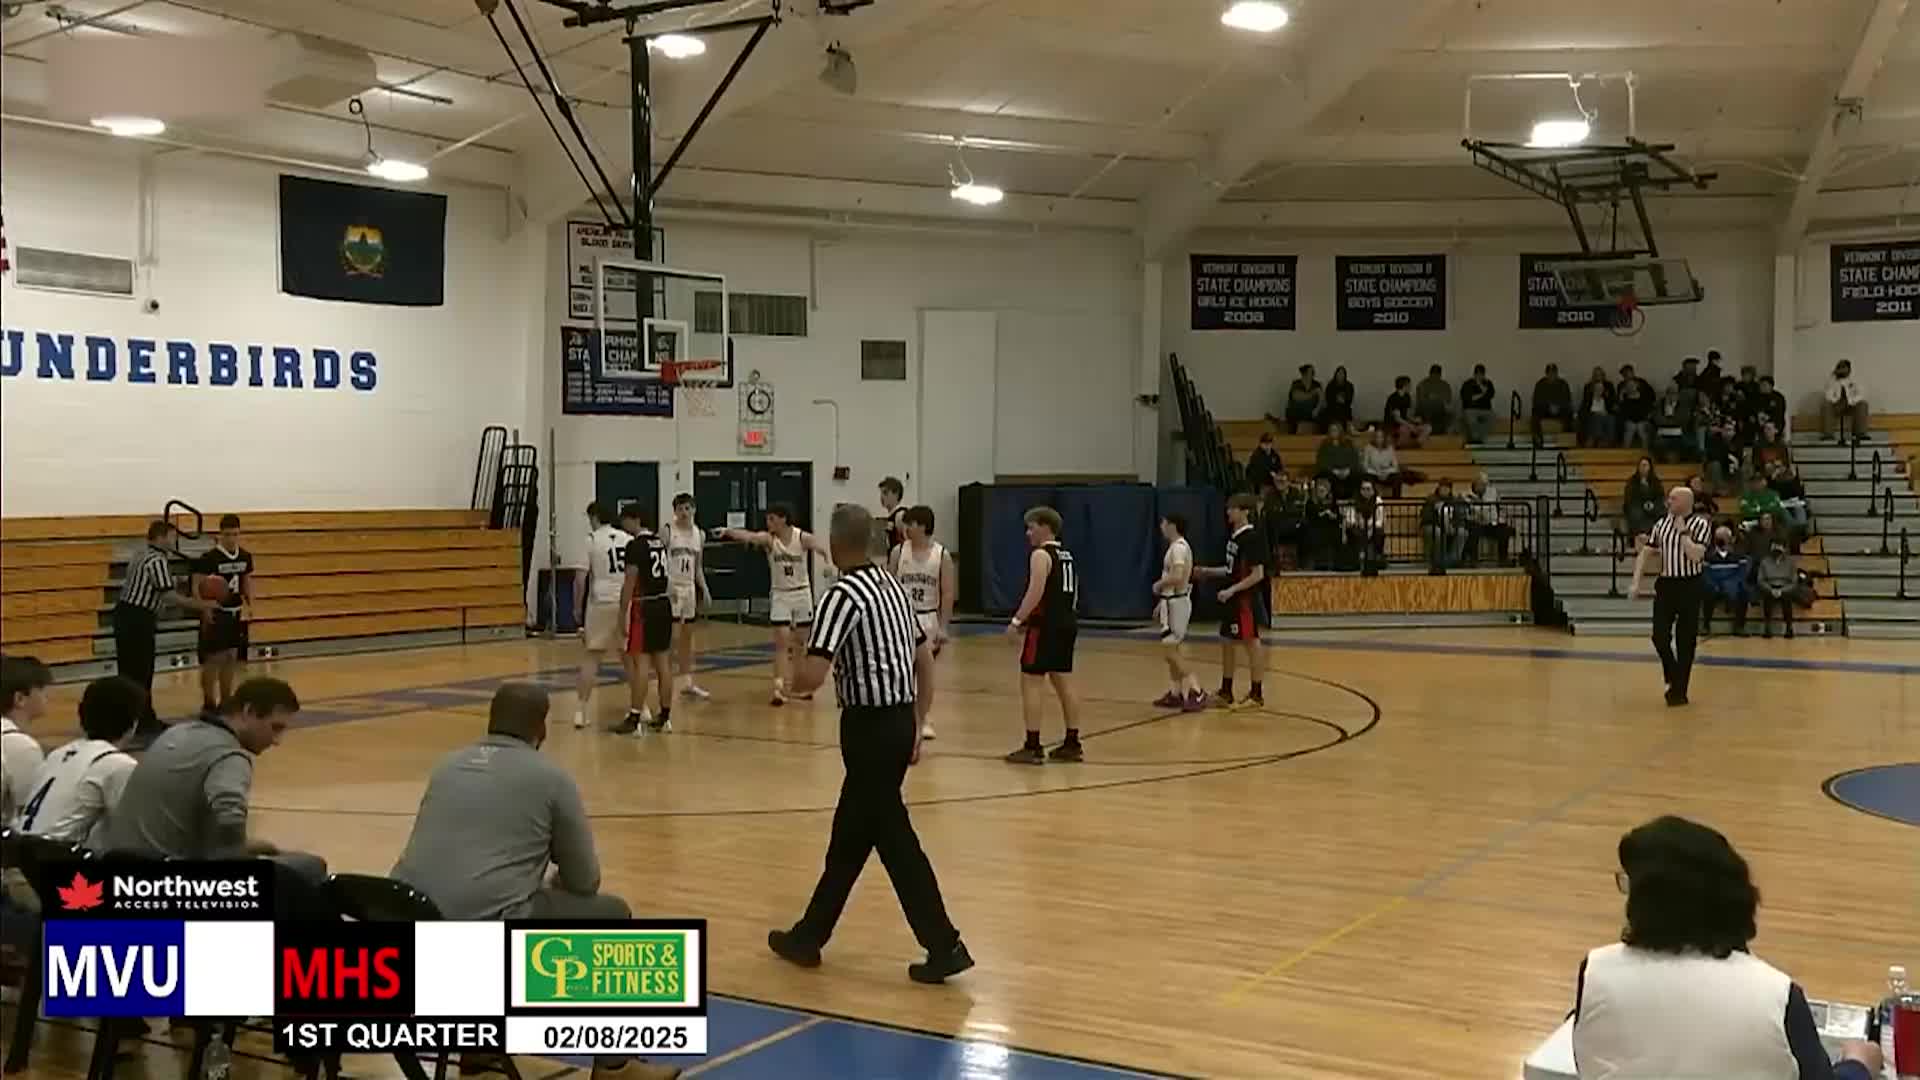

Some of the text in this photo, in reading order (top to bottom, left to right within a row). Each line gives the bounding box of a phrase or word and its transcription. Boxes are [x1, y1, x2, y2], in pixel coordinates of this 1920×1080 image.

[1839, 267, 1878, 282] STATE
[1197, 277, 1291, 292] STATE CHAMPIONS
[1344, 278, 1437, 292] STATE CHAMPIONS
[1842, 286, 1885, 298] FIELD
[1249, 296, 1289, 307] HOCKEY
[1347, 297, 1433, 308] BOYS SOCCER
[1876, 301, 1912, 312] 2011
[1373, 312, 1409, 323] 2010
[1557, 311, 1595, 323] 2010
[608, 547, 626, 574] 15
[1062, 561, 1074, 592] 11
[912, 587, 925, 602] 22
